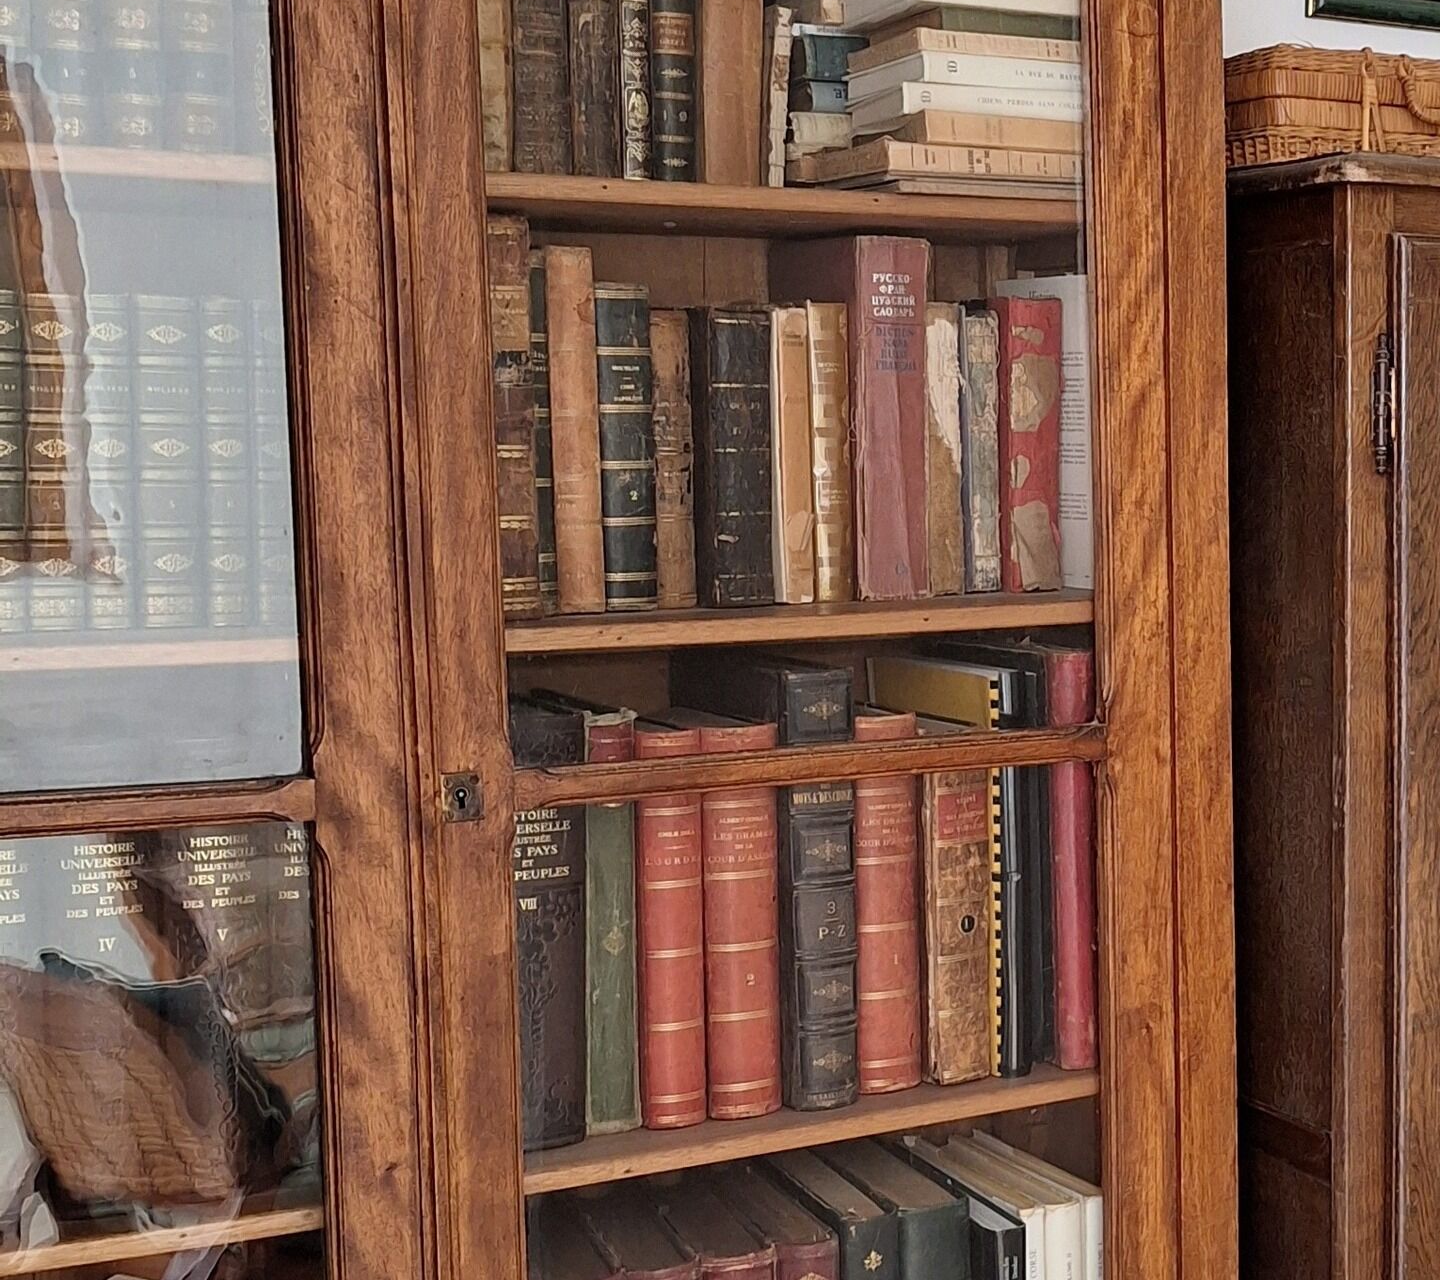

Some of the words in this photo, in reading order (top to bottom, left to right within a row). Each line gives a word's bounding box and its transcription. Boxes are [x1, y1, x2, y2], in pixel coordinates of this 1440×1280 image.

[629, 491, 638, 501] 2
[189, 834, 249, 848] HISTOIRE
[74, 841, 136, 856] HISTOIRE
[177, 846, 257, 862] UNIVERSELLE
[527, 844, 559, 858] PAYS
[60, 854, 145, 871] UNIVERSELLE
[194, 860, 247, 872] ILLUSTRÉE
[521, 858, 534, 868] ET
[707, 854, 735, 864] COUR
[78, 869, 132, 881] ILLUSTRÉE
[187, 874, 216, 886] DES
[221, 871, 252, 883] PAYS
[514, 866, 570, 881] PEUPLES
[72, 883, 99, 895] DES
[106, 880, 139, 892] PAYS
[215, 886, 231, 896] ET
[99, 896, 115, 905] ET
[182, 900, 204, 909] DES
[211, 895, 257, 908] PEUPLES
[277, 890, 300, 900] DES
[519, 897, 538, 911] VIII
[826, 901, 837, 915] 3
[66, 909, 88, 919] DES
[95, 904, 144, 917] PEUPLES
[216, 928, 228, 941] V
[98, 937, 116, 952] IV
[745, 973, 756, 986] 2
[1029, 1248, 1038, 1279] CORSE
